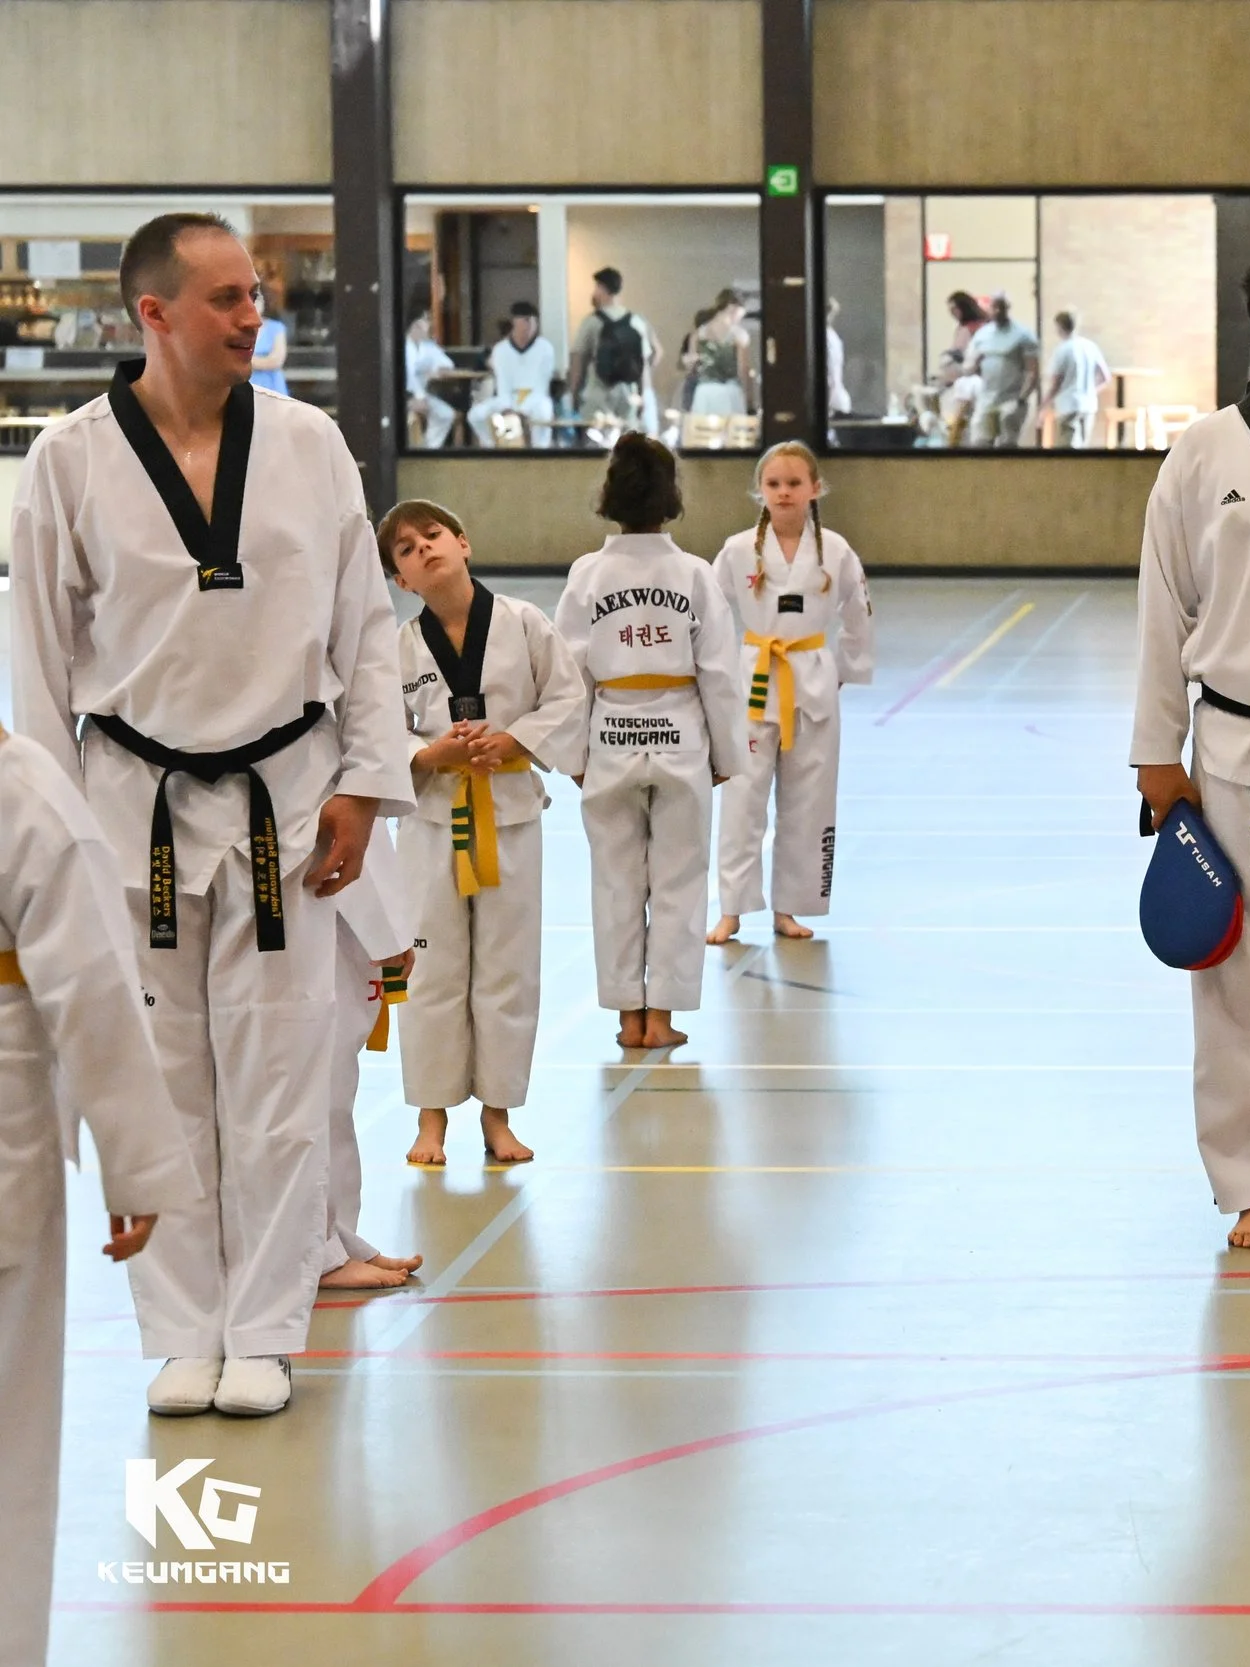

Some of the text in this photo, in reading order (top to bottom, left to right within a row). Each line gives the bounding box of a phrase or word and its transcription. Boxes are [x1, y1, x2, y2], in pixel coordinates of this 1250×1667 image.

[591, 587, 697, 626] AEKWOND
[618, 623, 673, 649] 태권도
[599, 730, 681, 746] KEUMGANG
[161, 845, 172, 917] David Beckers
[1191, 847, 1222, 887] TUSAH
